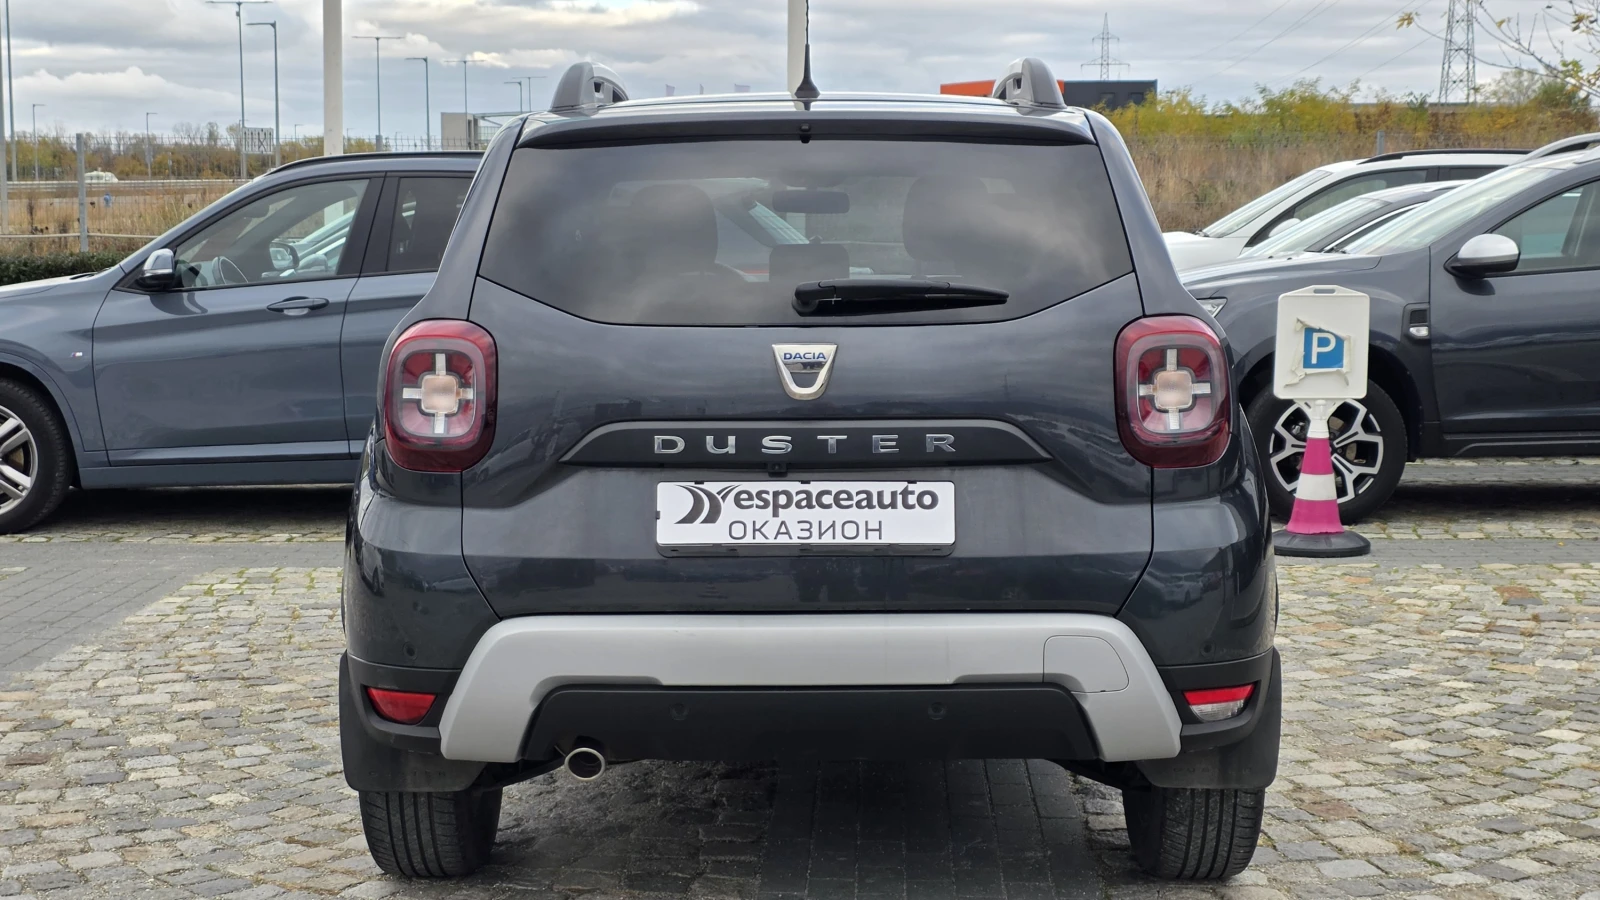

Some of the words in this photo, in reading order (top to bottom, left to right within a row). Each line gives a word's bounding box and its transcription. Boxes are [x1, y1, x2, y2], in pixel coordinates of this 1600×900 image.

[783, 352, 827, 360] DACIA
[1311, 332, 1336, 364] P
[653, 433, 957, 455] DUSTER
[733, 484, 939, 518] espaceauto
[728, 520, 883, 541] ОКАЗИОН
